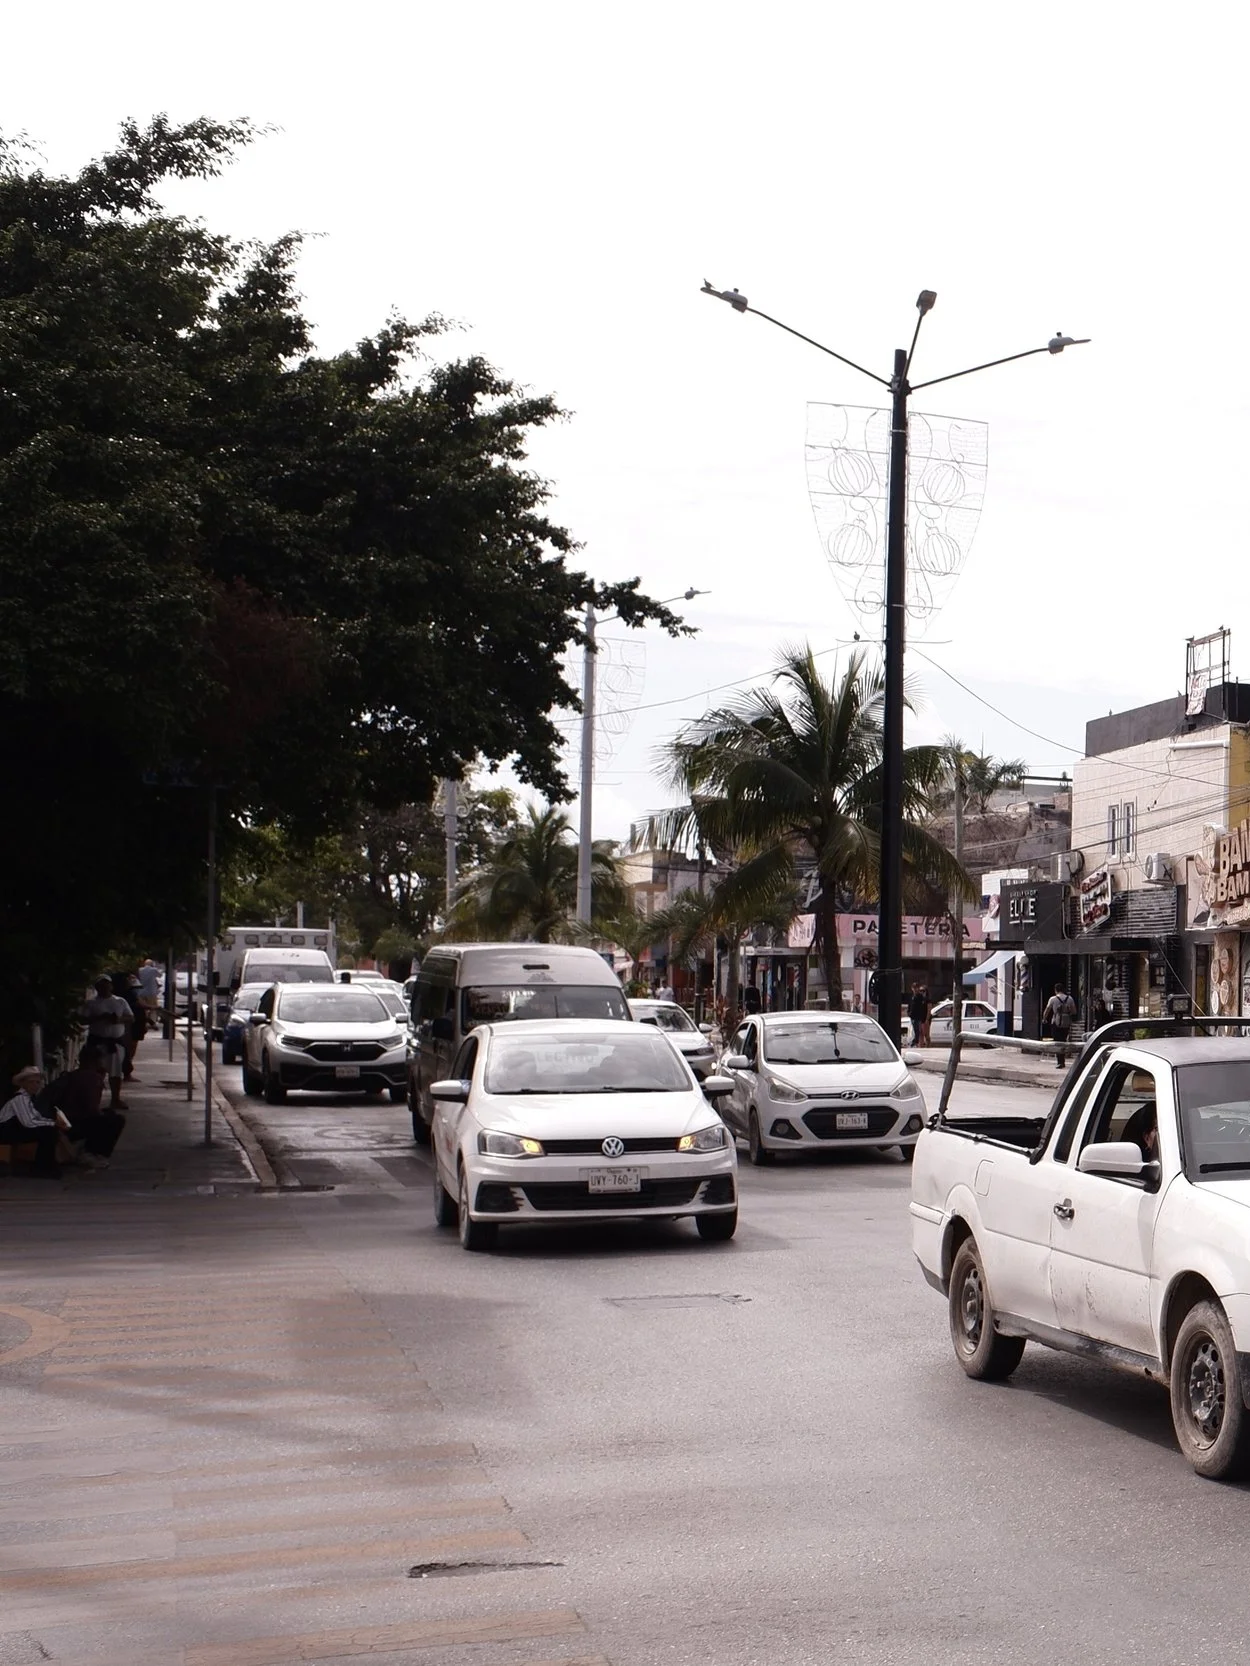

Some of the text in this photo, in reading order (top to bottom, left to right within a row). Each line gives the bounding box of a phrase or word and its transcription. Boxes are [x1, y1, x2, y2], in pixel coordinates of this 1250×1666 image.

[1217, 870, 1250, 901] BAM
[853, 919, 971, 938] PAETERA
[591, 1174, 639, 1186] UVY-760-J
